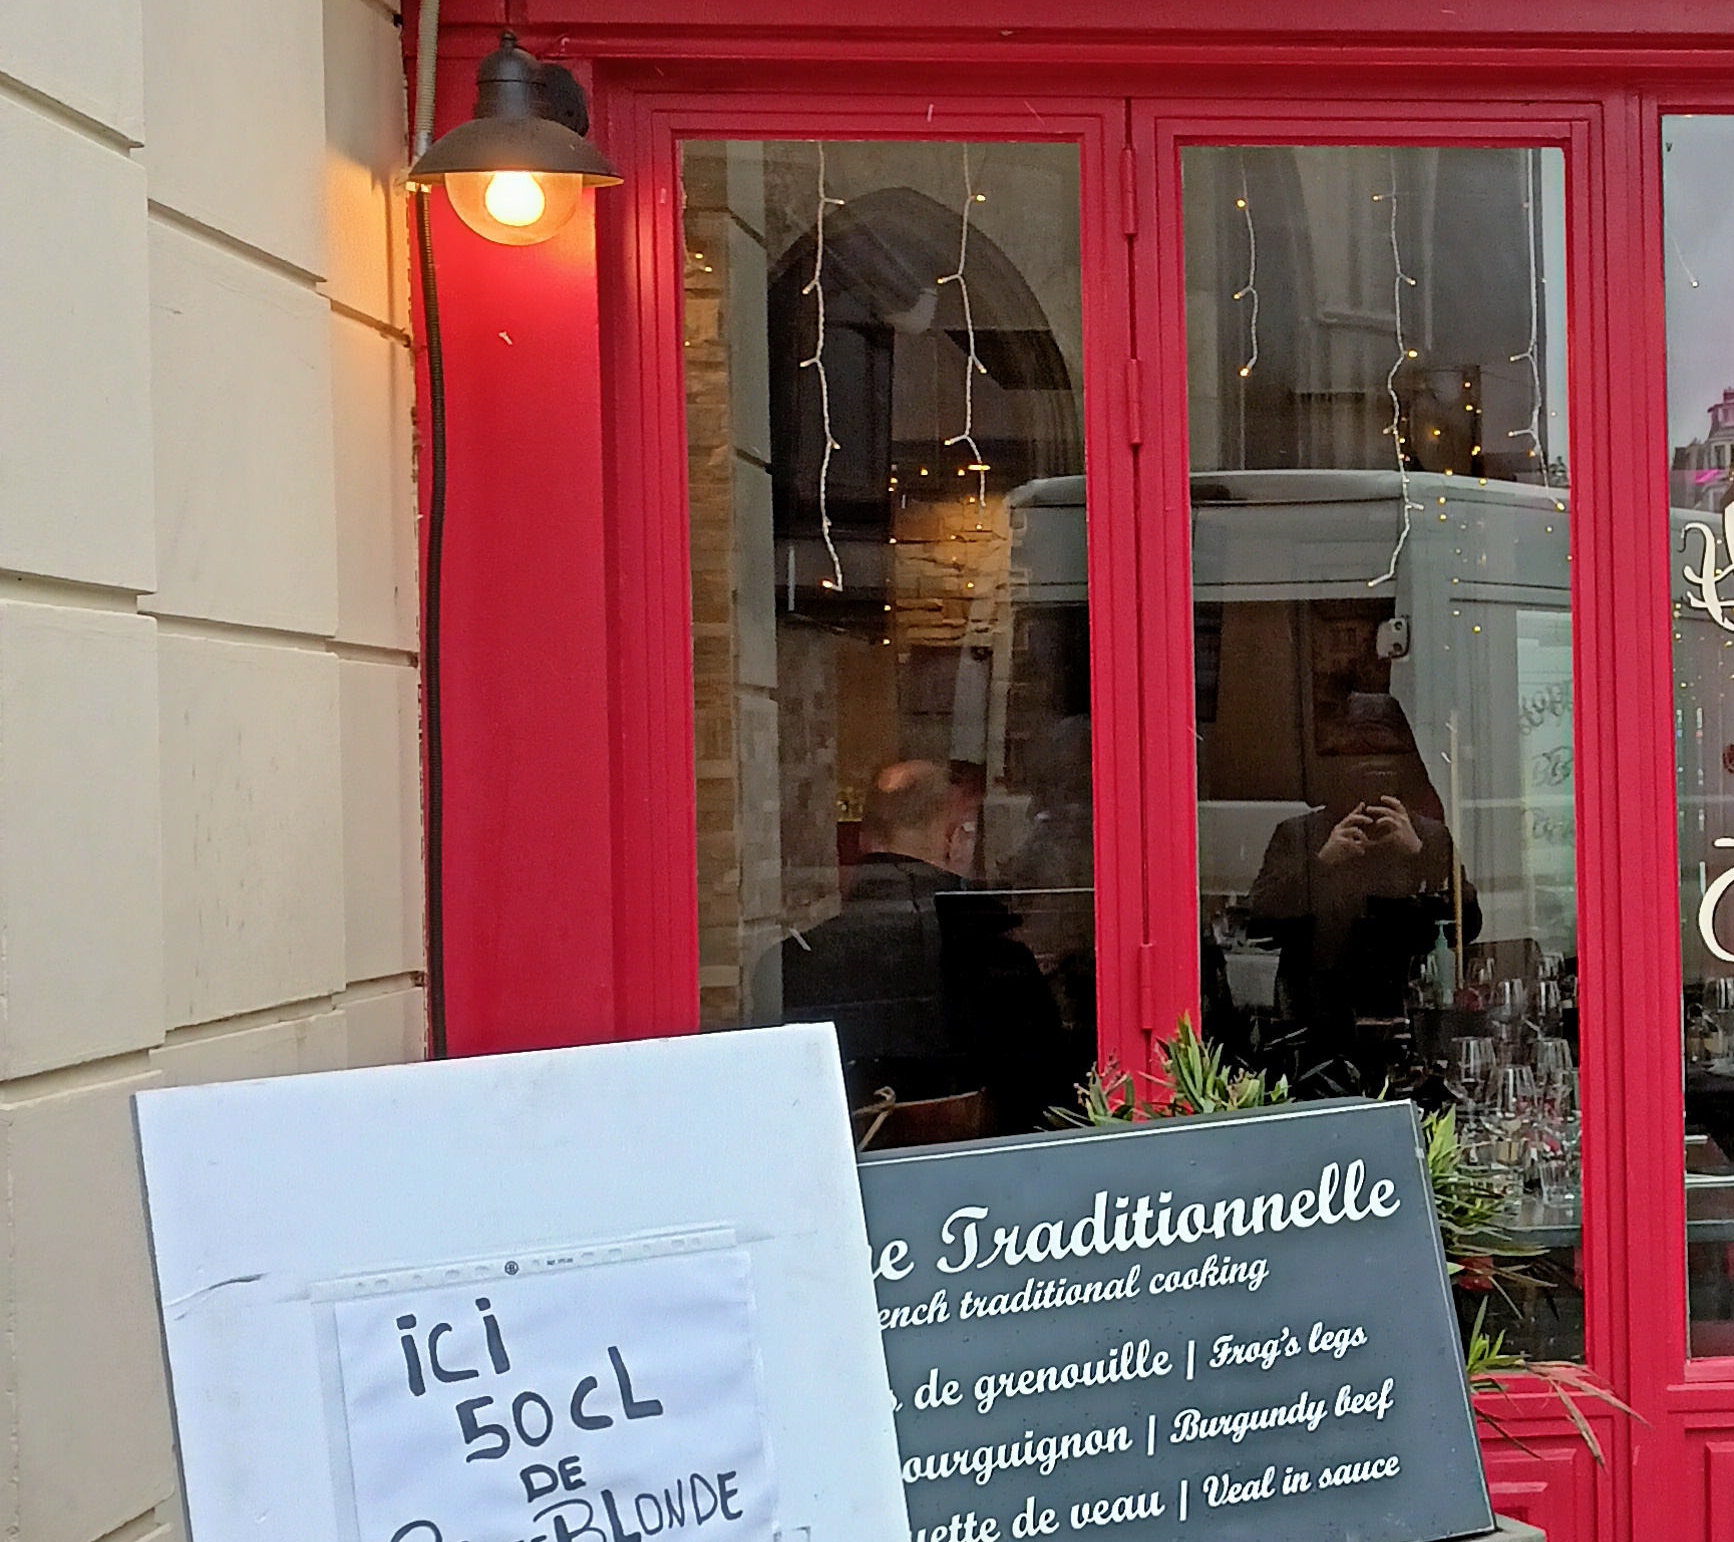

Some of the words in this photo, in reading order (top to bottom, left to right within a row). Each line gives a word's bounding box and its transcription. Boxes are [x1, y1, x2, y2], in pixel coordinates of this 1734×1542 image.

[936, 1159, 1401, 1274] Traditionnelle
[959, 1264, 1141, 1317] traditional
[1148, 1252, 1270, 1293] cooking
[914, 1367, 963, 1411] de
[974, 1339, 1173, 1414] grenouille
[1209, 1326, 1302, 1369] Frog's
[1308, 1321, 1367, 1358] legs
[1170, 1391, 1327, 1444] Burgundy
[1334, 1378, 1395, 1420] beef
[519, 1455, 587, 1504] DE
[1011, 1496, 1060, 1540] de
[1070, 1489, 1165, 1529] veau
[1202, 1465, 1276, 1509] Veal
[1282, 1464, 1311, 1494] in
[1318, 1454, 1400, 1490] sauce
